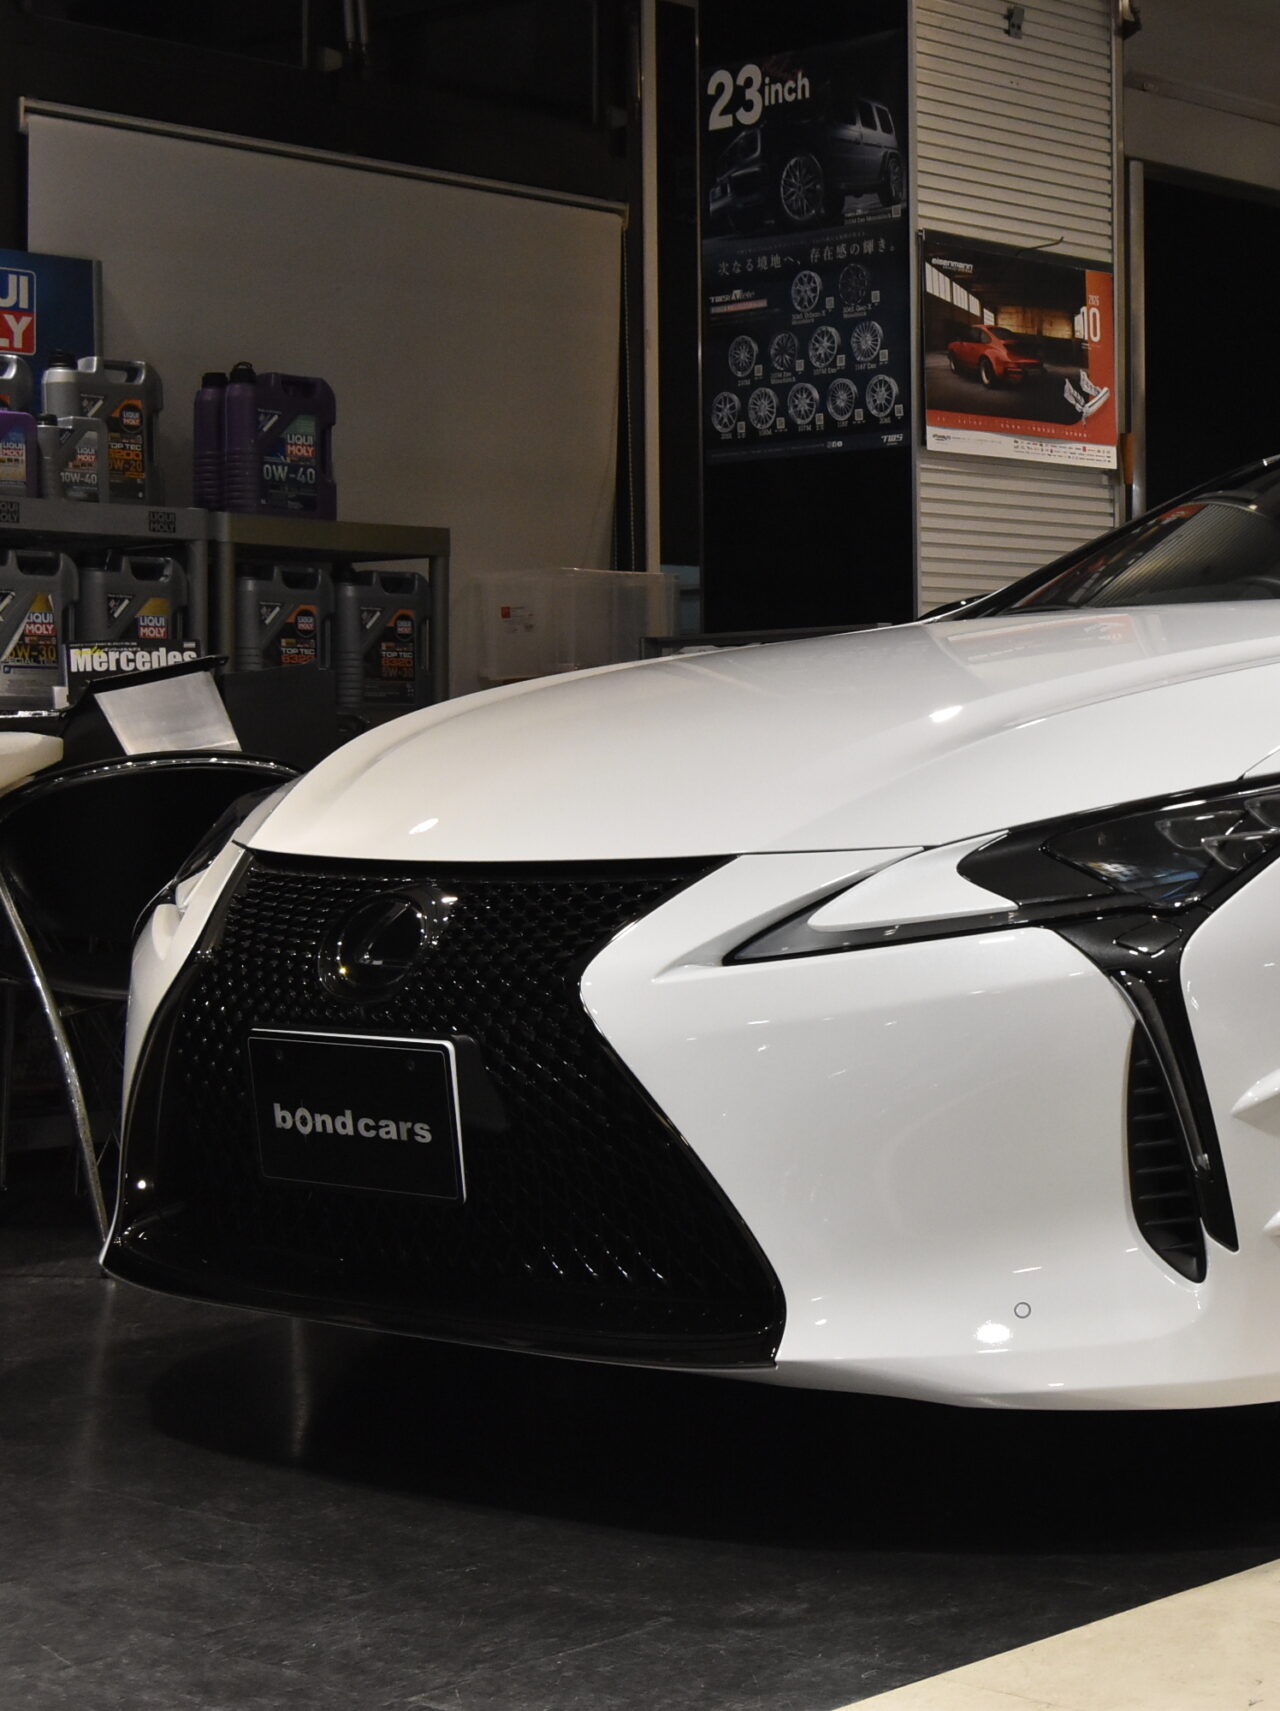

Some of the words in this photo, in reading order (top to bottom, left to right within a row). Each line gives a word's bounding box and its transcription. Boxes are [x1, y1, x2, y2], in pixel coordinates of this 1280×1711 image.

[287, 434, 314, 445] LIQUI
[287, 445, 315, 456] MOLY
[60, 471, 98, 484] 10W-40
[262, 464, 316, 484] 0W-40
[139, 616, 165, 627] LIQUI
[25, 623, 54, 634] MOLY
[139, 626, 167, 637] MOLY
